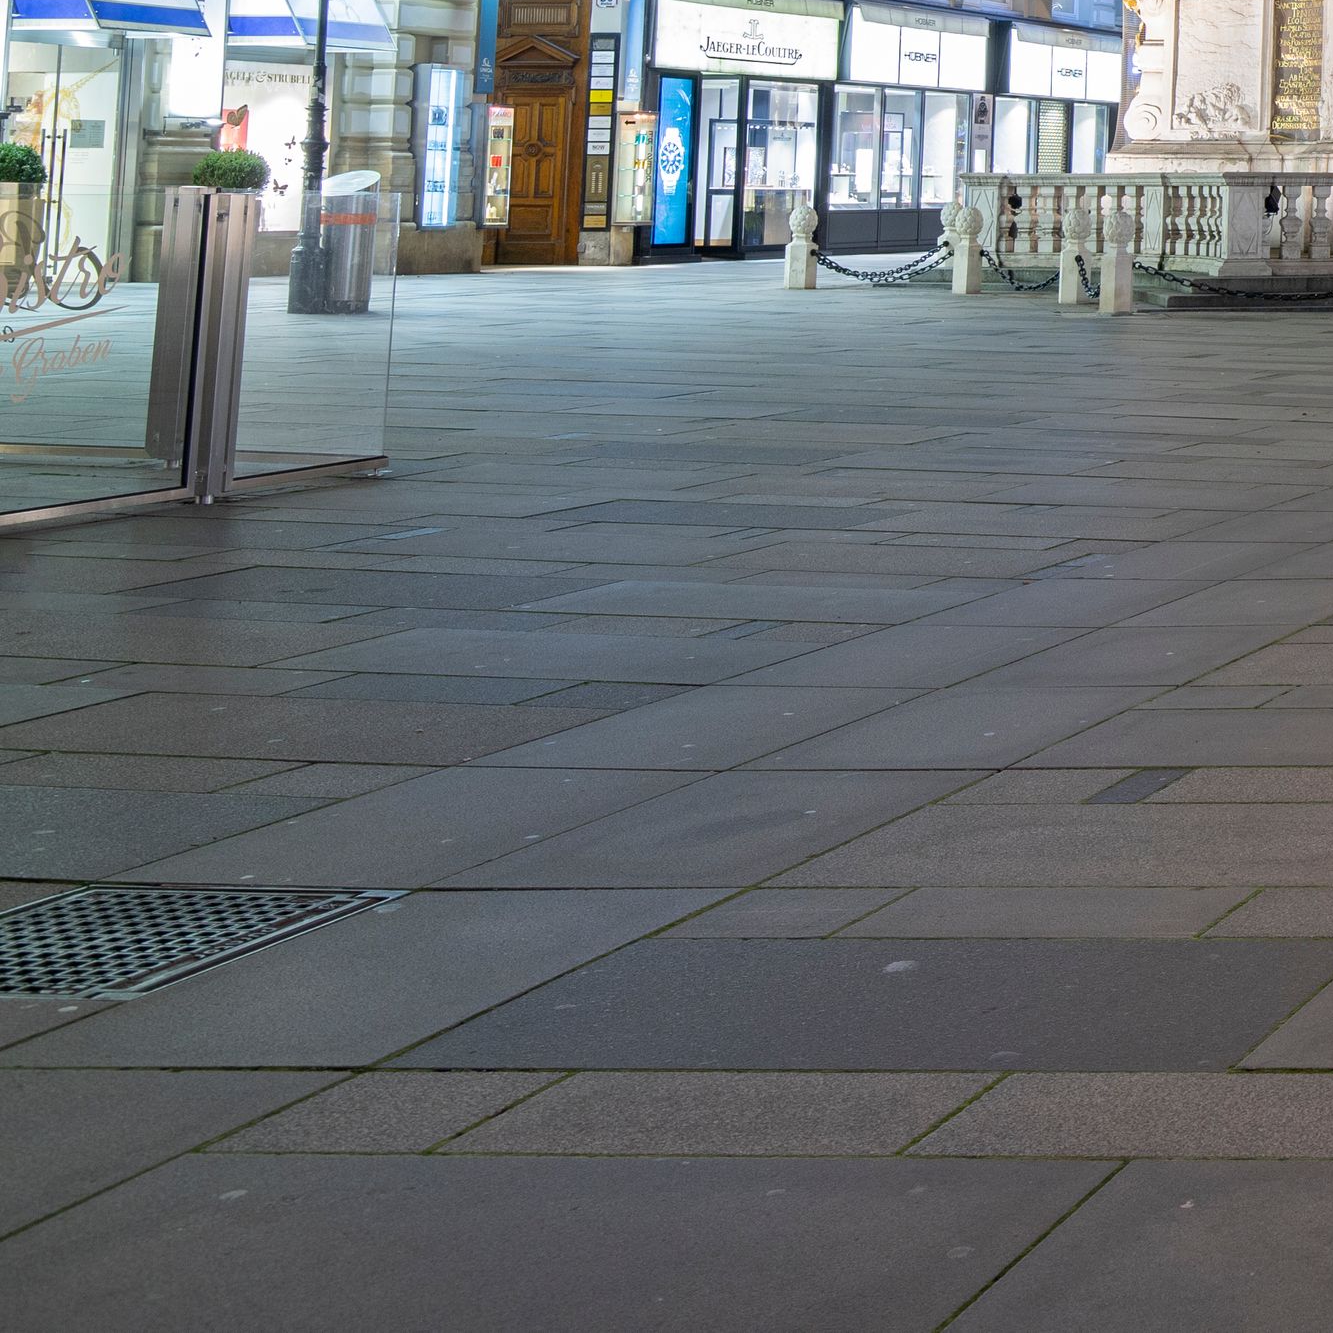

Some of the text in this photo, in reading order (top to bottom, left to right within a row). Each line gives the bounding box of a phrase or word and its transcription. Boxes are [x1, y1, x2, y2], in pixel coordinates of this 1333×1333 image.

[904, 51, 937, 63] HÜBNER
[225, 67, 254, 83] ÄGELE
[11, 335, 113, 403] Graben
